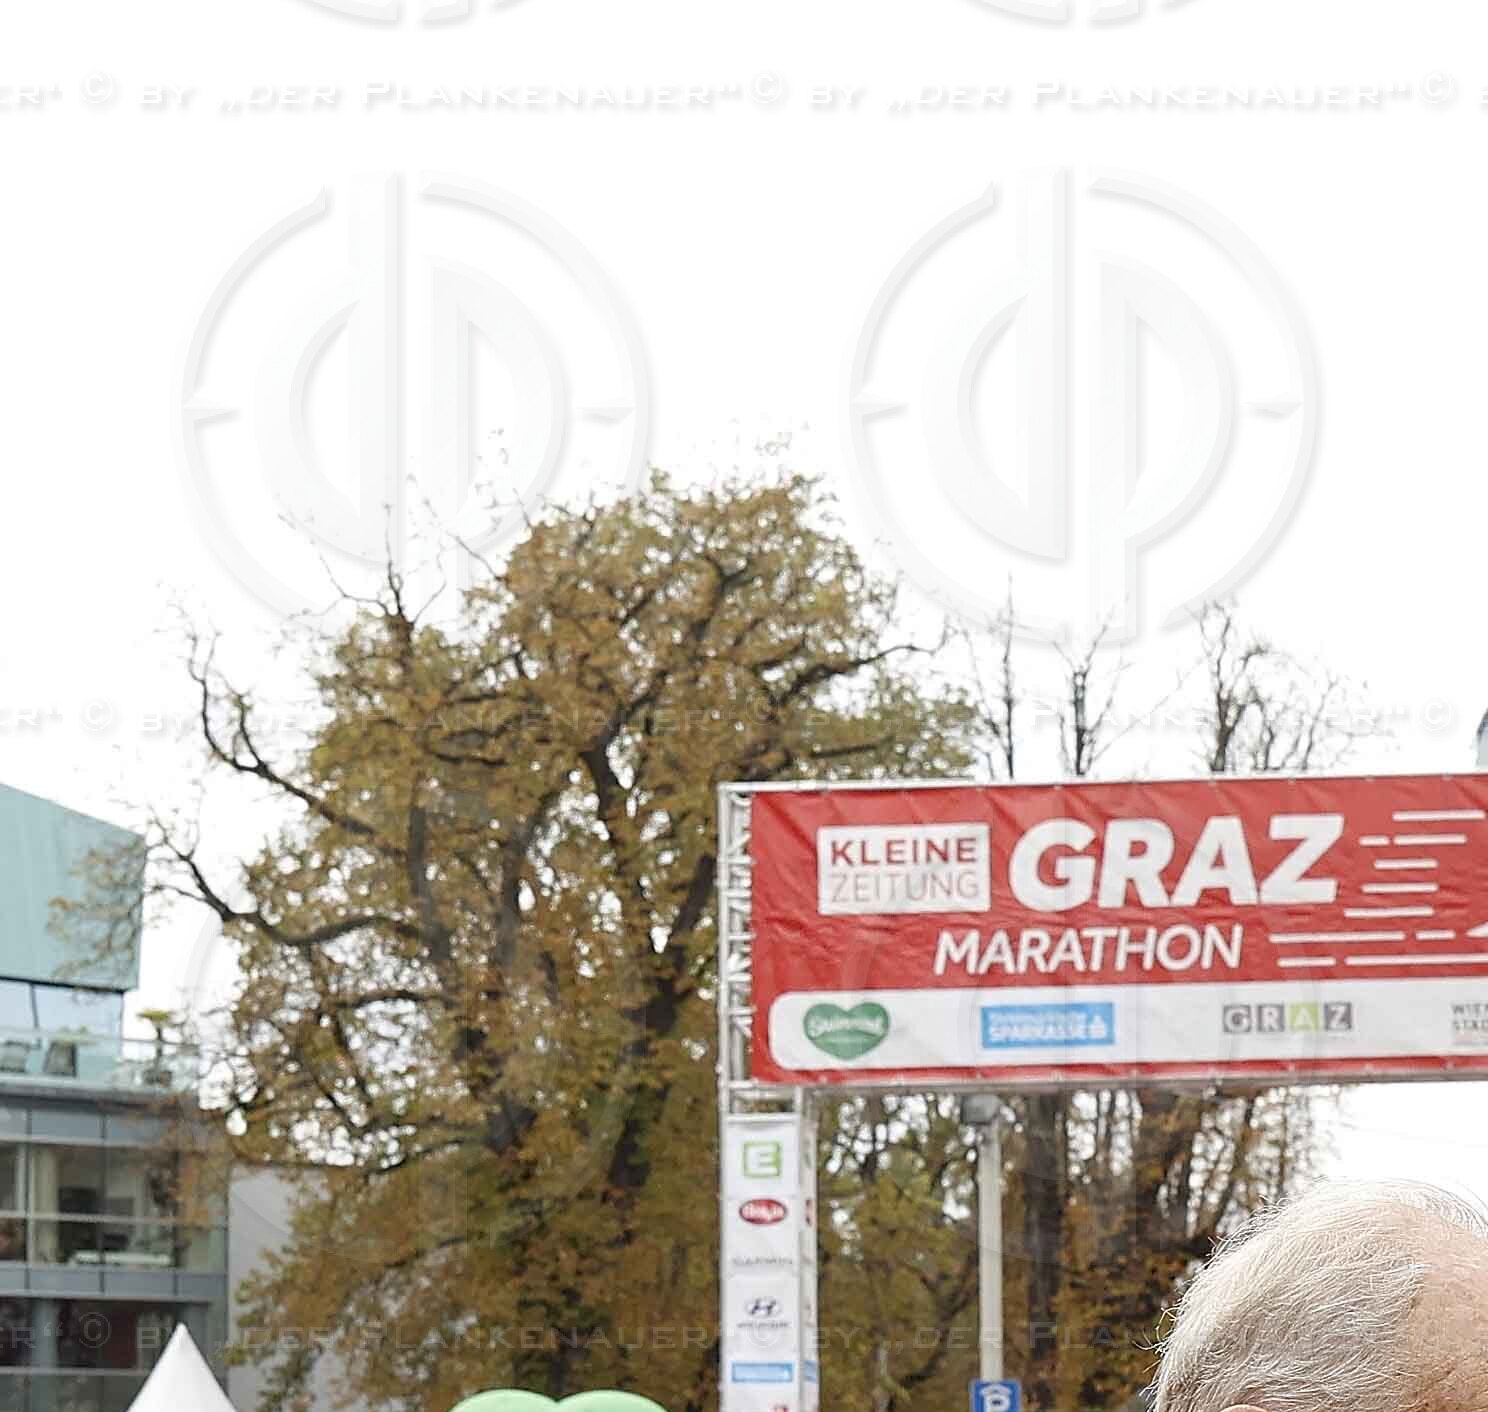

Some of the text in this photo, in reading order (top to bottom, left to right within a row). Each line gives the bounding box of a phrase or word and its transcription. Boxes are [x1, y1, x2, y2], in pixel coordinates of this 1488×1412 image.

[830, 834, 978, 868] KLEINE
[1009, 813, 1345, 913] GRAZ
[830, 869, 980, 905] ZEITUNG
[934, 923, 1243, 977] MARATHON
[1223, 1003, 1353, 1034] GRAZ
